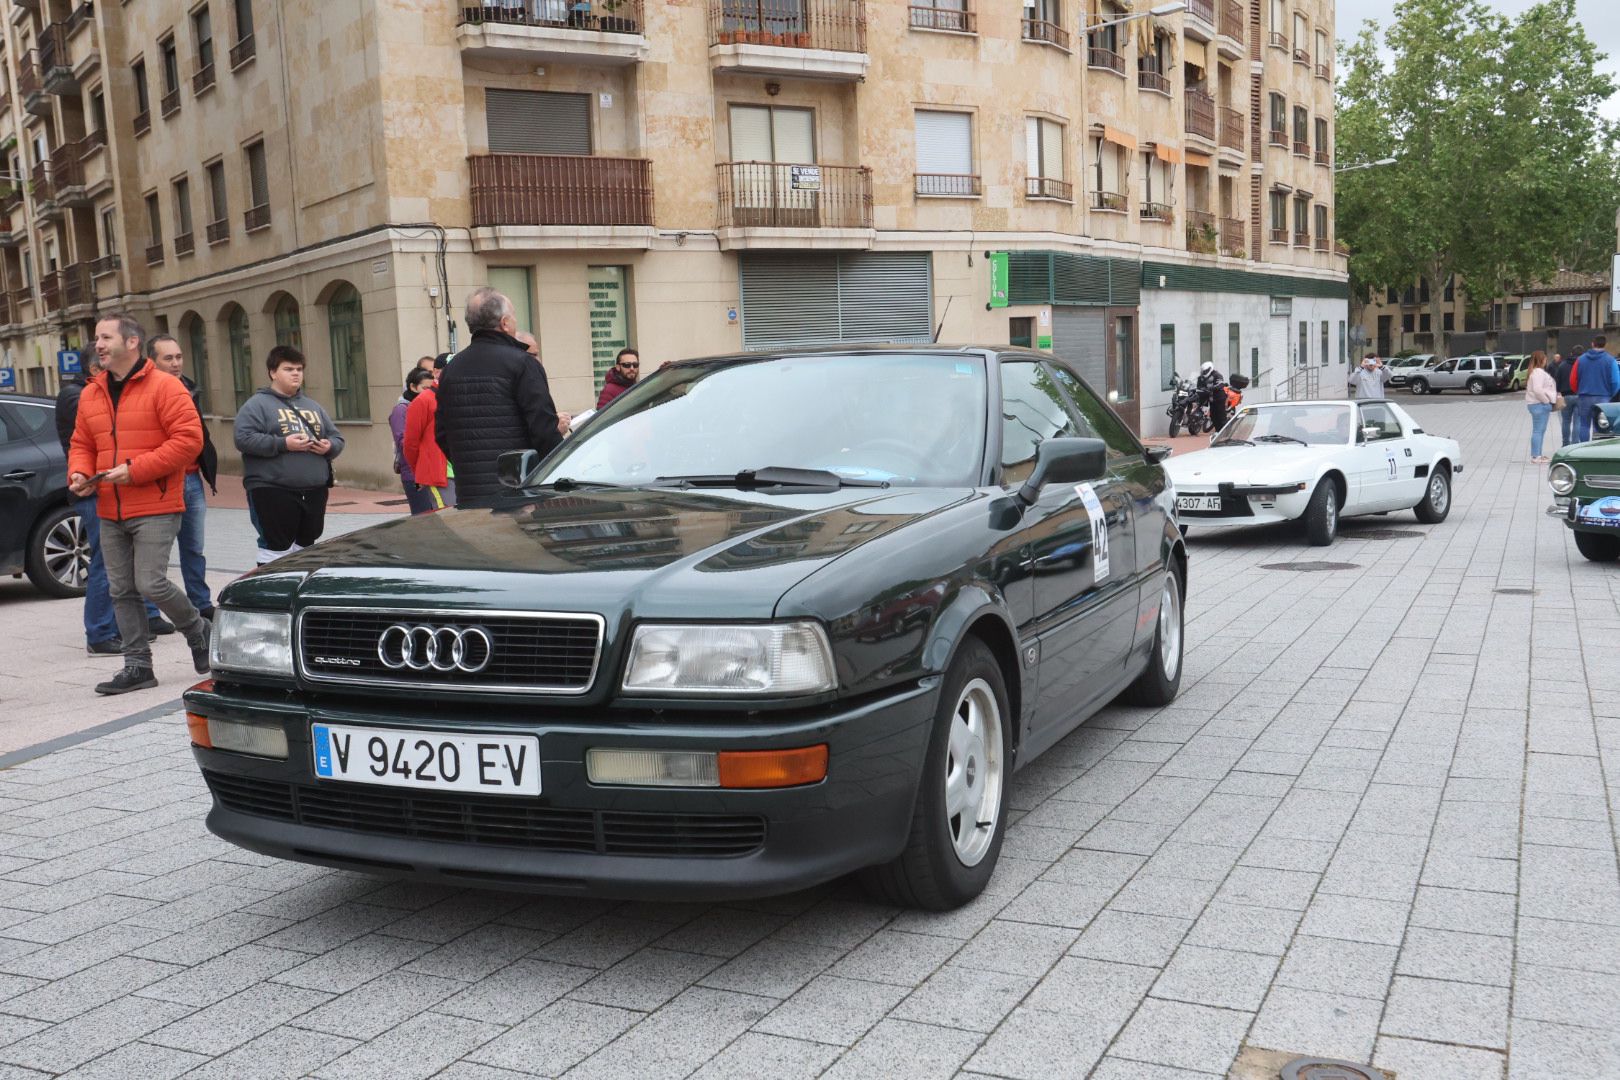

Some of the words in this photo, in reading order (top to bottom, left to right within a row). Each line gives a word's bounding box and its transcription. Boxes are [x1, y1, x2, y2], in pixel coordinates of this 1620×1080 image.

[793, 167, 800, 175] SE
[62, 352, 78, 371] P
[278, 408, 321, 425] JEDI
[1388, 458, 1397, 475] 11
[1094, 518, 1108, 562] 42
[314, 656, 361, 666] quattro
[320, 756, 328, 768] E
[332, 733, 351, 774] V
[368, 736, 460, 783] 9420
[477, 743, 527, 786] EV
